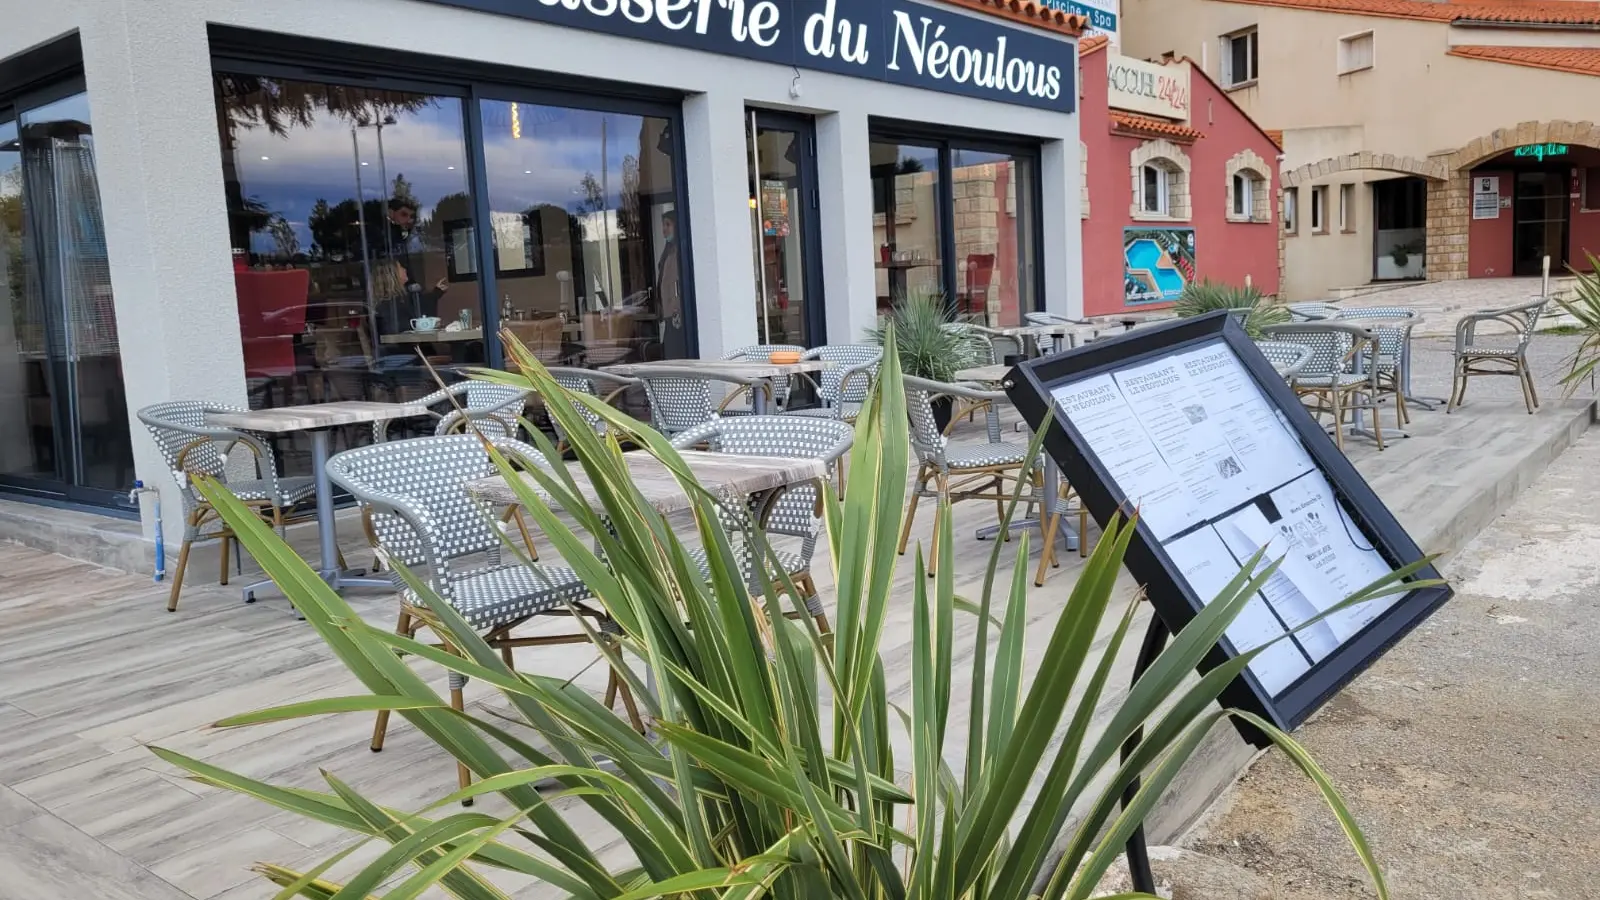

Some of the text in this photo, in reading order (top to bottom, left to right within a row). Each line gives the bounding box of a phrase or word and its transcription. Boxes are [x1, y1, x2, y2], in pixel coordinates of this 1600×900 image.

[1094, 10, 1112, 27] Spa
[803, 0, 869, 65] du
[887, 10, 1061, 100] Néoulous
[1123, 366, 1175, 388] RESTAURANT
[1060, 384, 1112, 407] ESTAURANT
